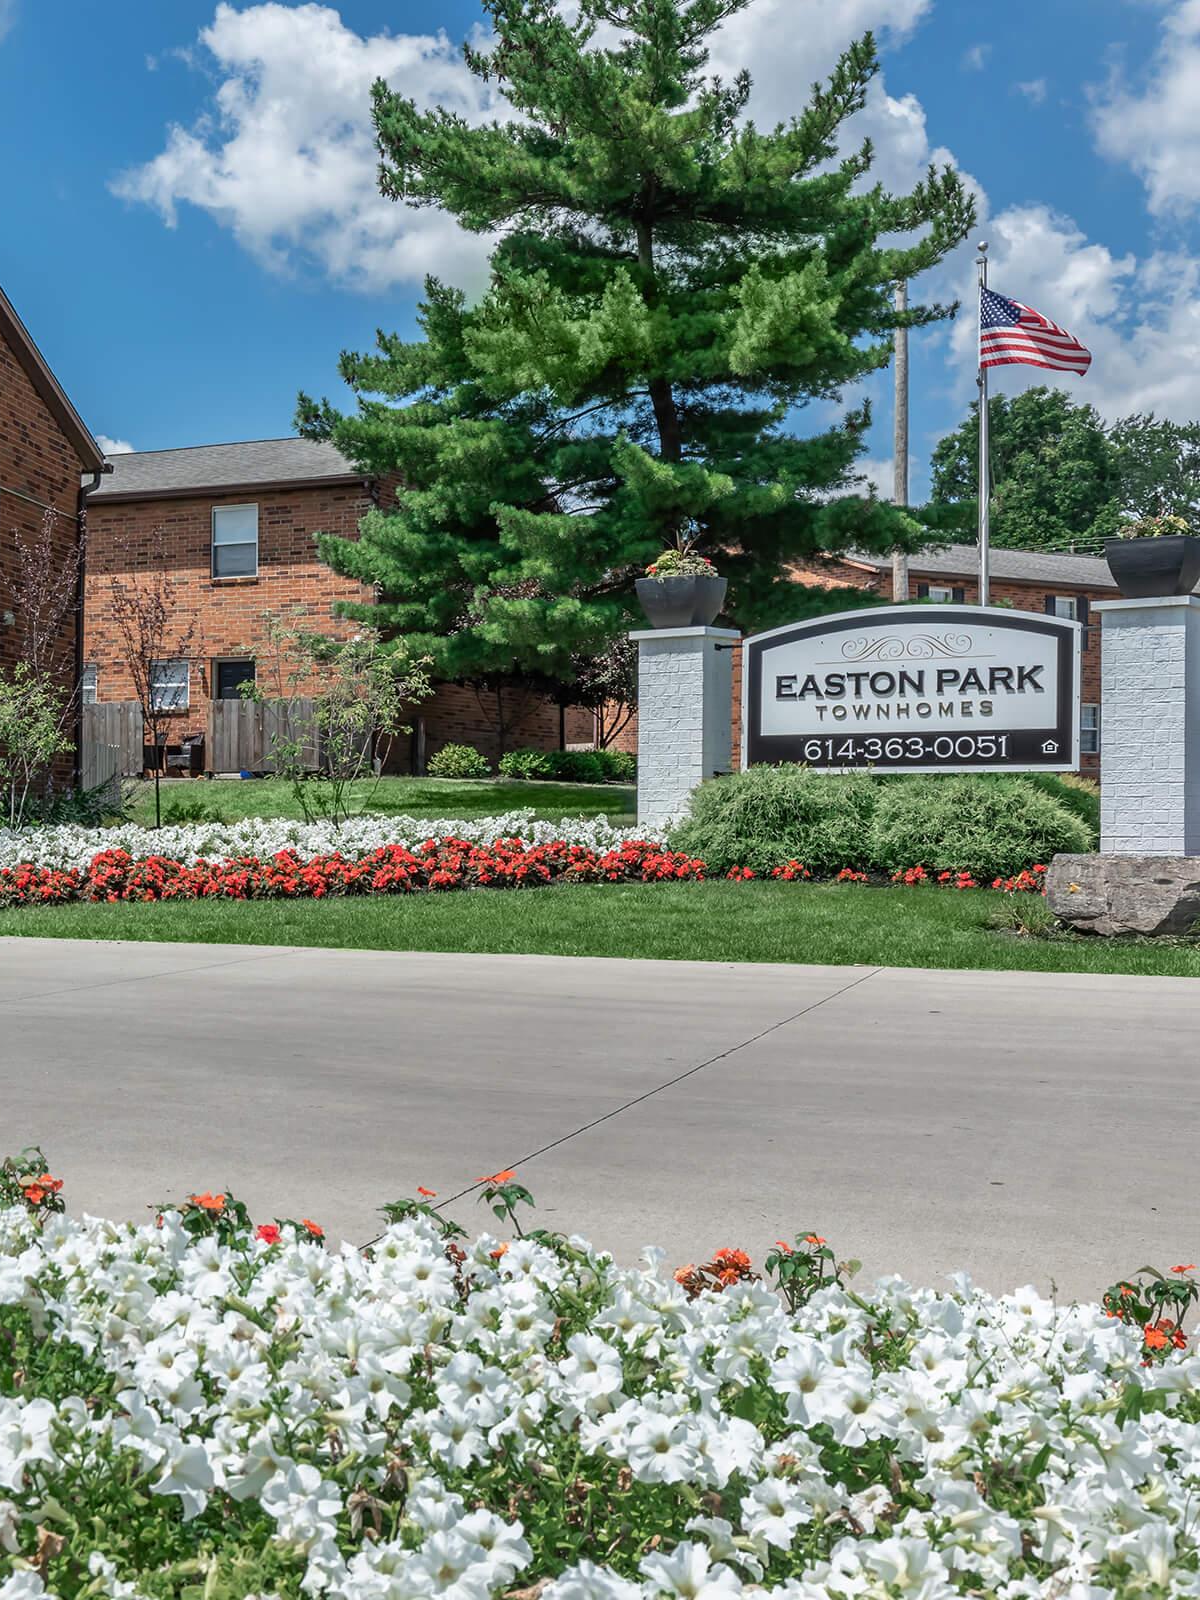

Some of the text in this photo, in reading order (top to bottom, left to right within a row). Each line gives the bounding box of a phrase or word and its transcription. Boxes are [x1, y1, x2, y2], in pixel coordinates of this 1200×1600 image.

[775, 664, 1045, 700] EASTON PARK
[815, 700, 994, 722] TOWNHOMES
[803, 736, 1008, 761] 614-363-0051
